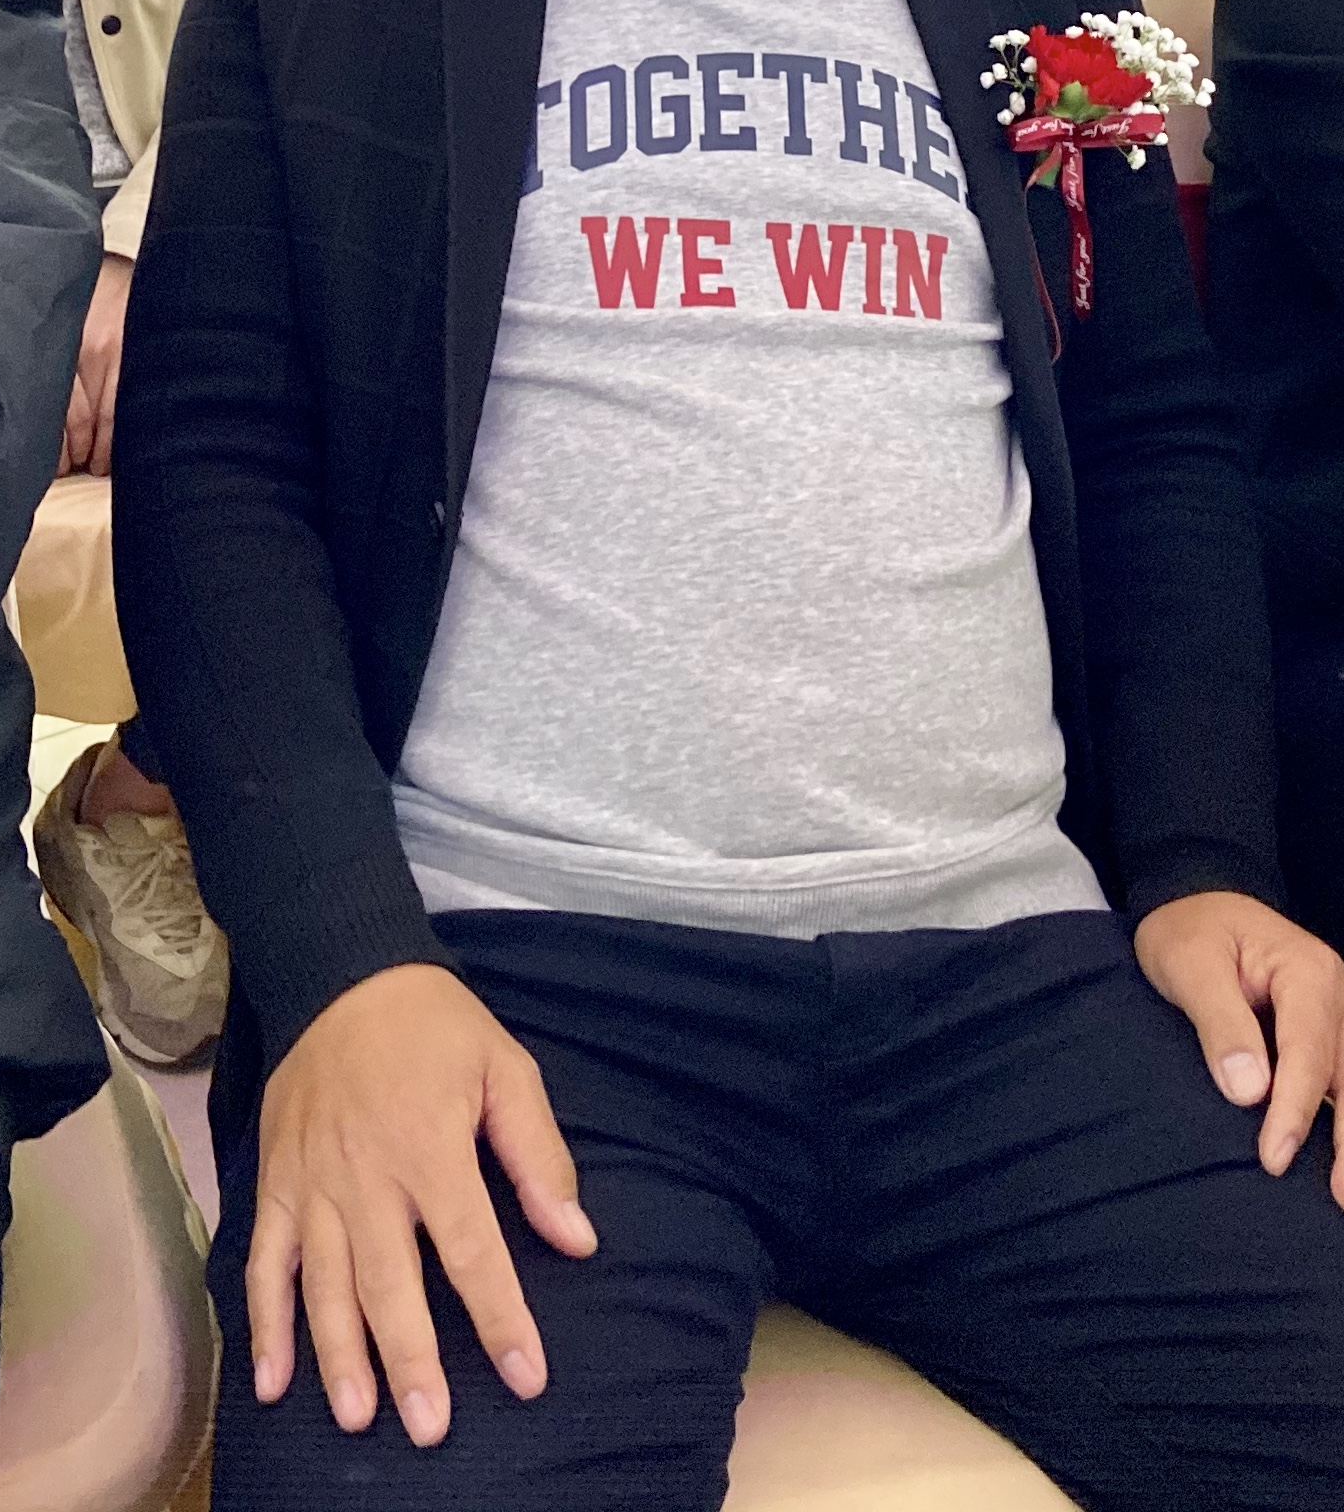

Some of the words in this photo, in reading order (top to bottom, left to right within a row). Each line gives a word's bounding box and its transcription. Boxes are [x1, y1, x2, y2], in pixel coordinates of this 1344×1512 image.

[519, 52, 968, 204] TOGETHE
[580, 216, 737, 310] WE
[764, 222, 949, 320] WIN
